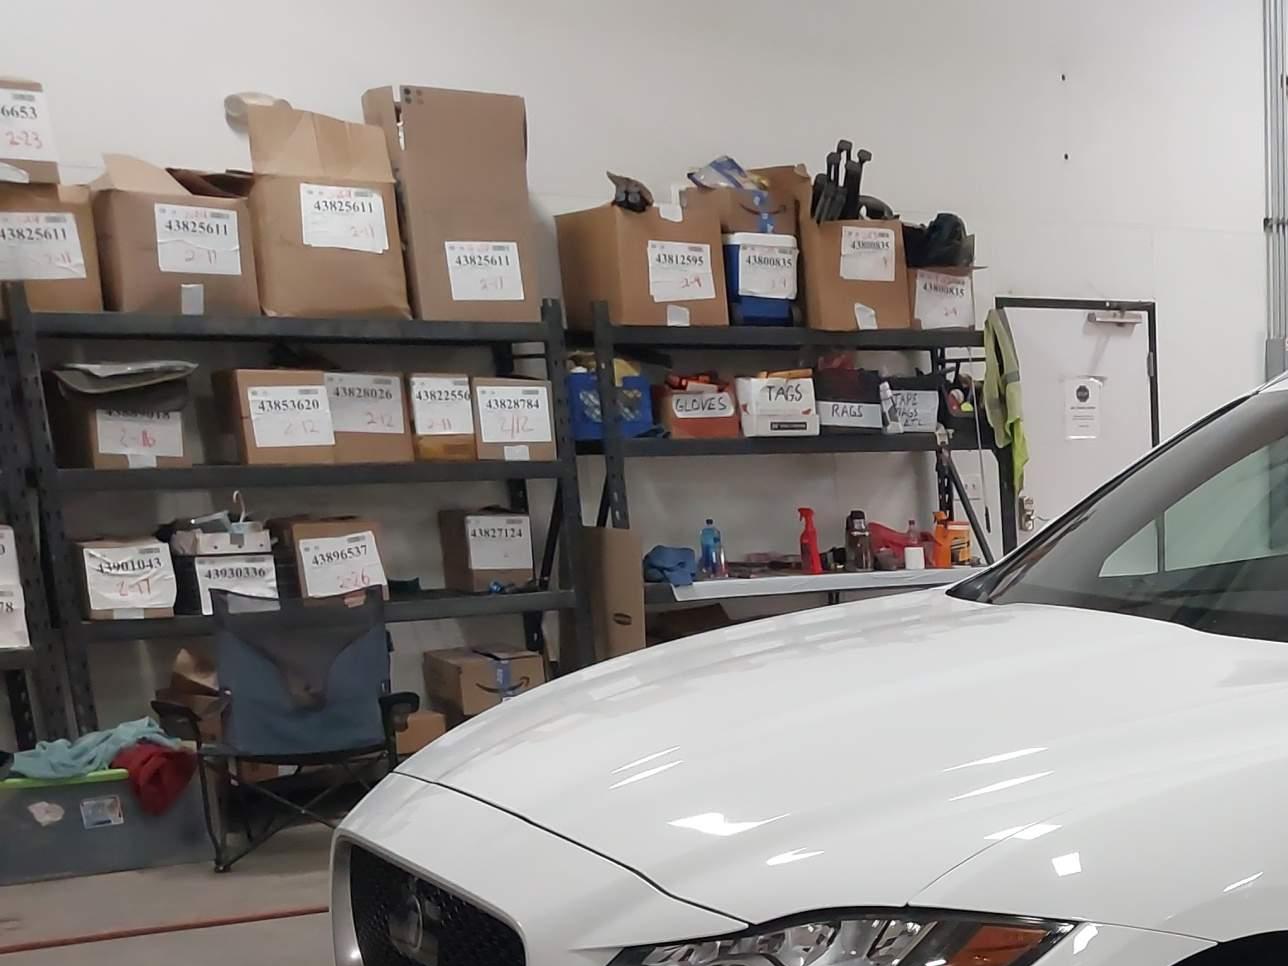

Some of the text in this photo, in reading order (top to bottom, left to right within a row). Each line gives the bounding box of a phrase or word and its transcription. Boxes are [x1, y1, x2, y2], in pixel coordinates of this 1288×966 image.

[314, 200, 373, 214] 43825611
[165, 219, 228, 236] 43825611
[456, 255, 510, 267] 43825611
[656, 253, 704, 266] 43812595
[746, 255, 793, 268] 43800835
[332, 386, 393, 400] 43828026
[415, 389, 471, 401] 43822556
[767, 383, 803, 402] TAGS
[258, 399, 320, 412] 43853620
[485, 398, 540, 410] 43828784
[675, 396, 727, 412] GLOVES
[831, 403, 864, 418] RAGS
[470, 527, 523, 538] 43827124
[311, 544, 367, 566] 43896537
[204, 566, 266, 580] 43930336
